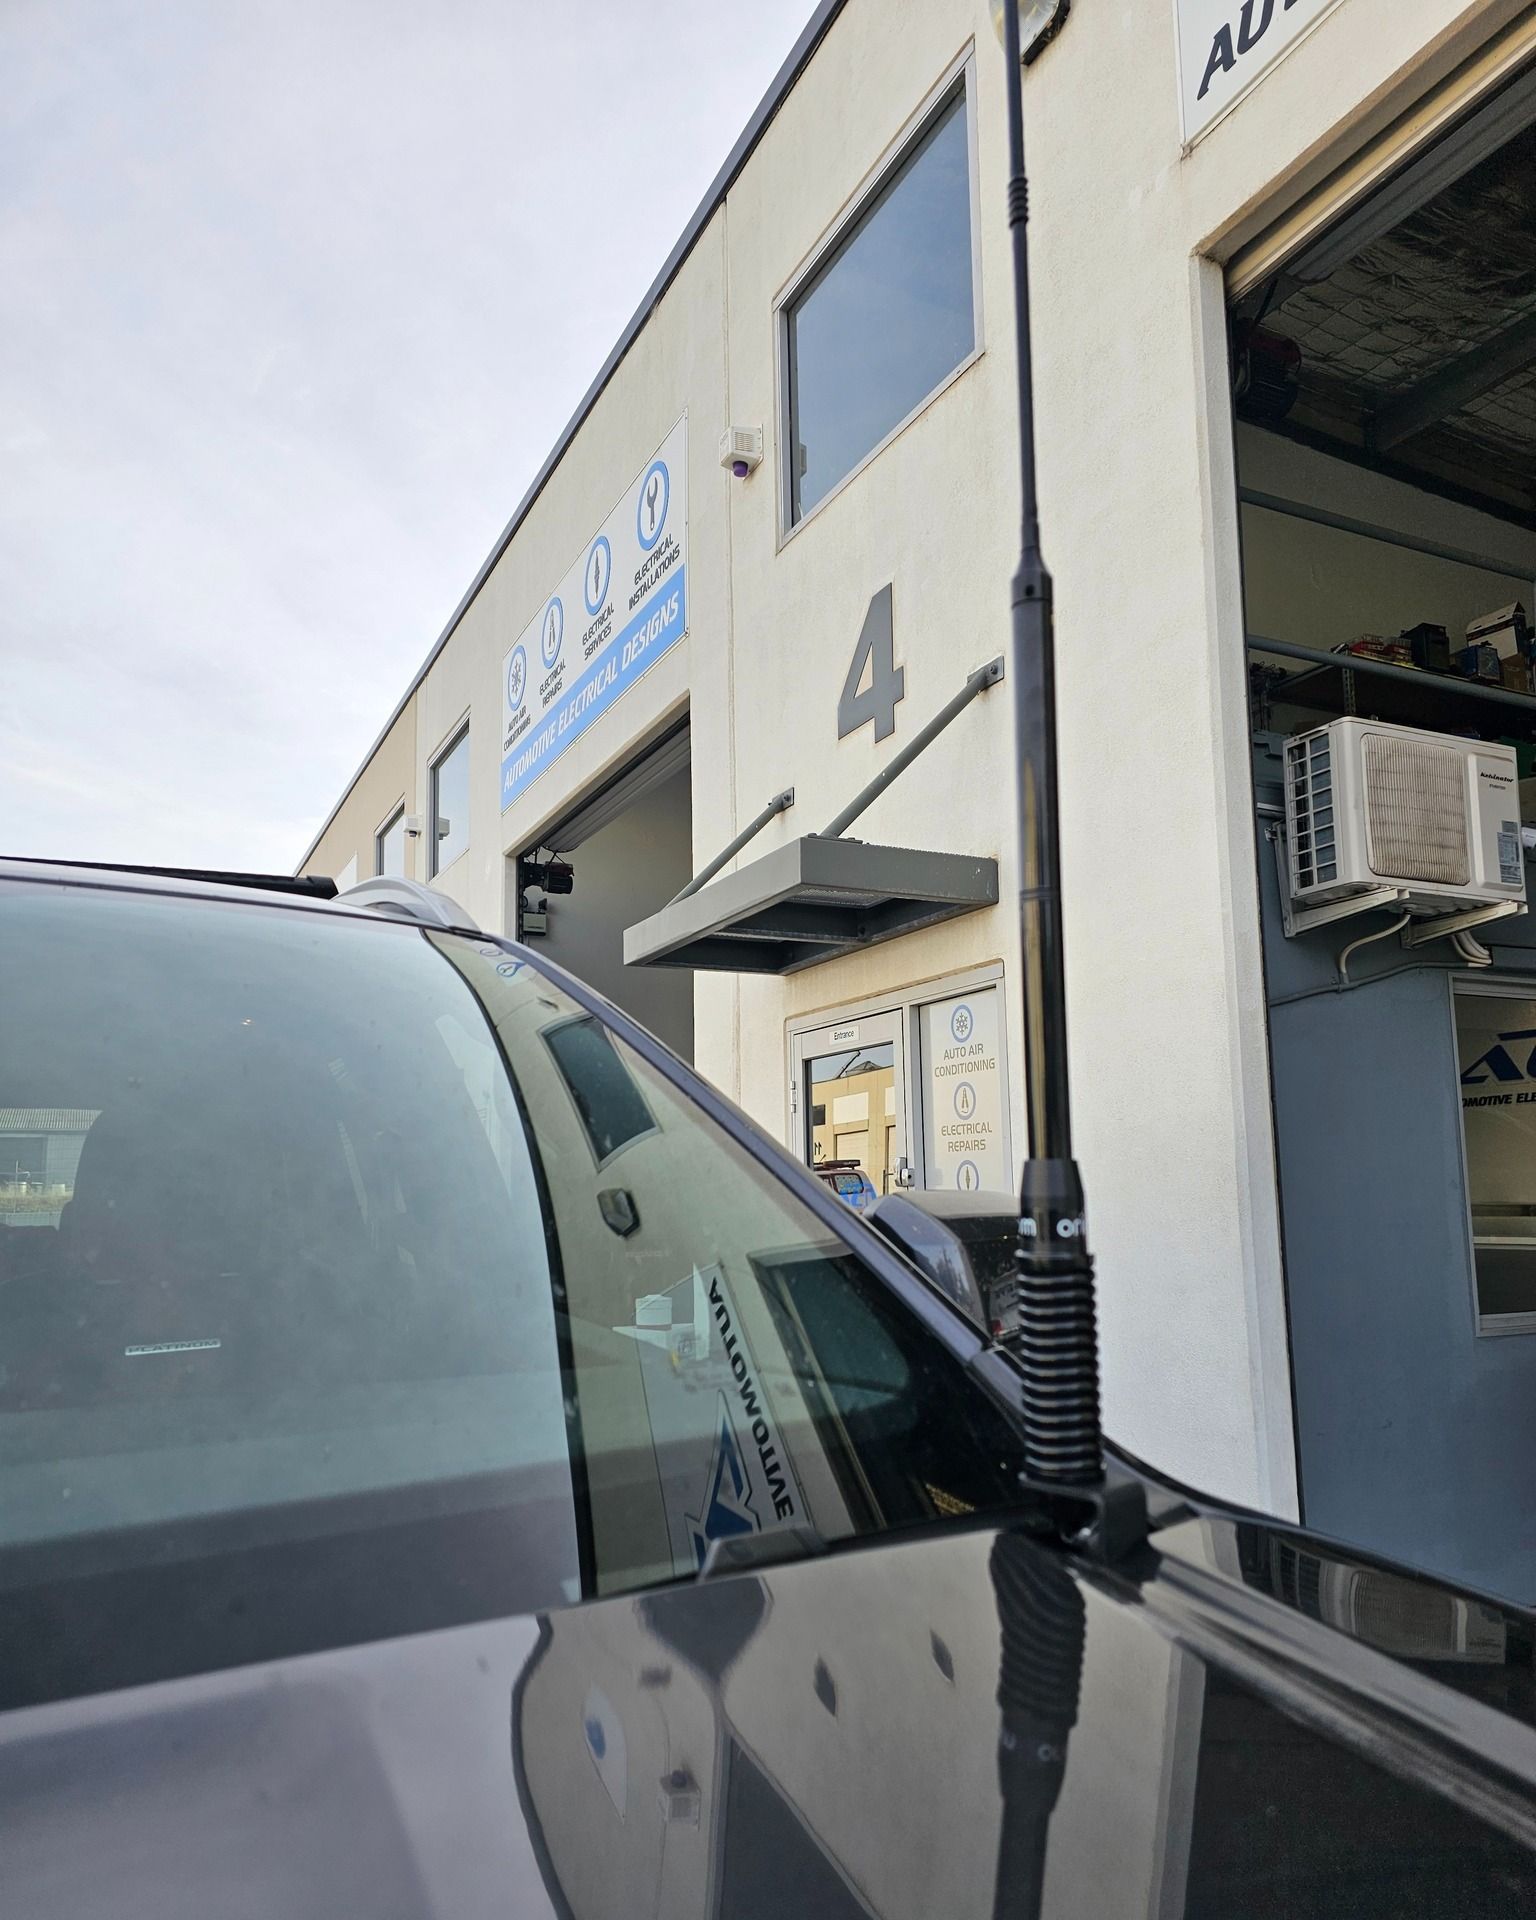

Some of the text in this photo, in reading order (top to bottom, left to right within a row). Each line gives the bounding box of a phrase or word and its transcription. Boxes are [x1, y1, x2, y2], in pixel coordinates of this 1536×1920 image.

[1197, 0, 1297, 100] AU
[628, 543, 680, 611] INSTALLATIONS
[634, 533, 674, 585] ELECTRICAL
[582, 602, 615, 645] ELECTRICAL
[584, 621, 612, 660] SERVICES
[539, 658, 566, 695] ELECTRICAL
[837, 582, 904, 743] 4
[503, 590, 680, 792] AUTOMOTIVE ELECTRICAL DESIGNS
[542, 677, 563, 708] REPAIRS
[834, 1030, 854, 1040] Entrance
[943, 1043, 984, 1060] AUTO AIR
[934, 1057, 996, 1078] CONDITIONING
[941, 1121, 993, 1136] ELECTRICAL
[947, 1139, 986, 1152] REPAIRS
